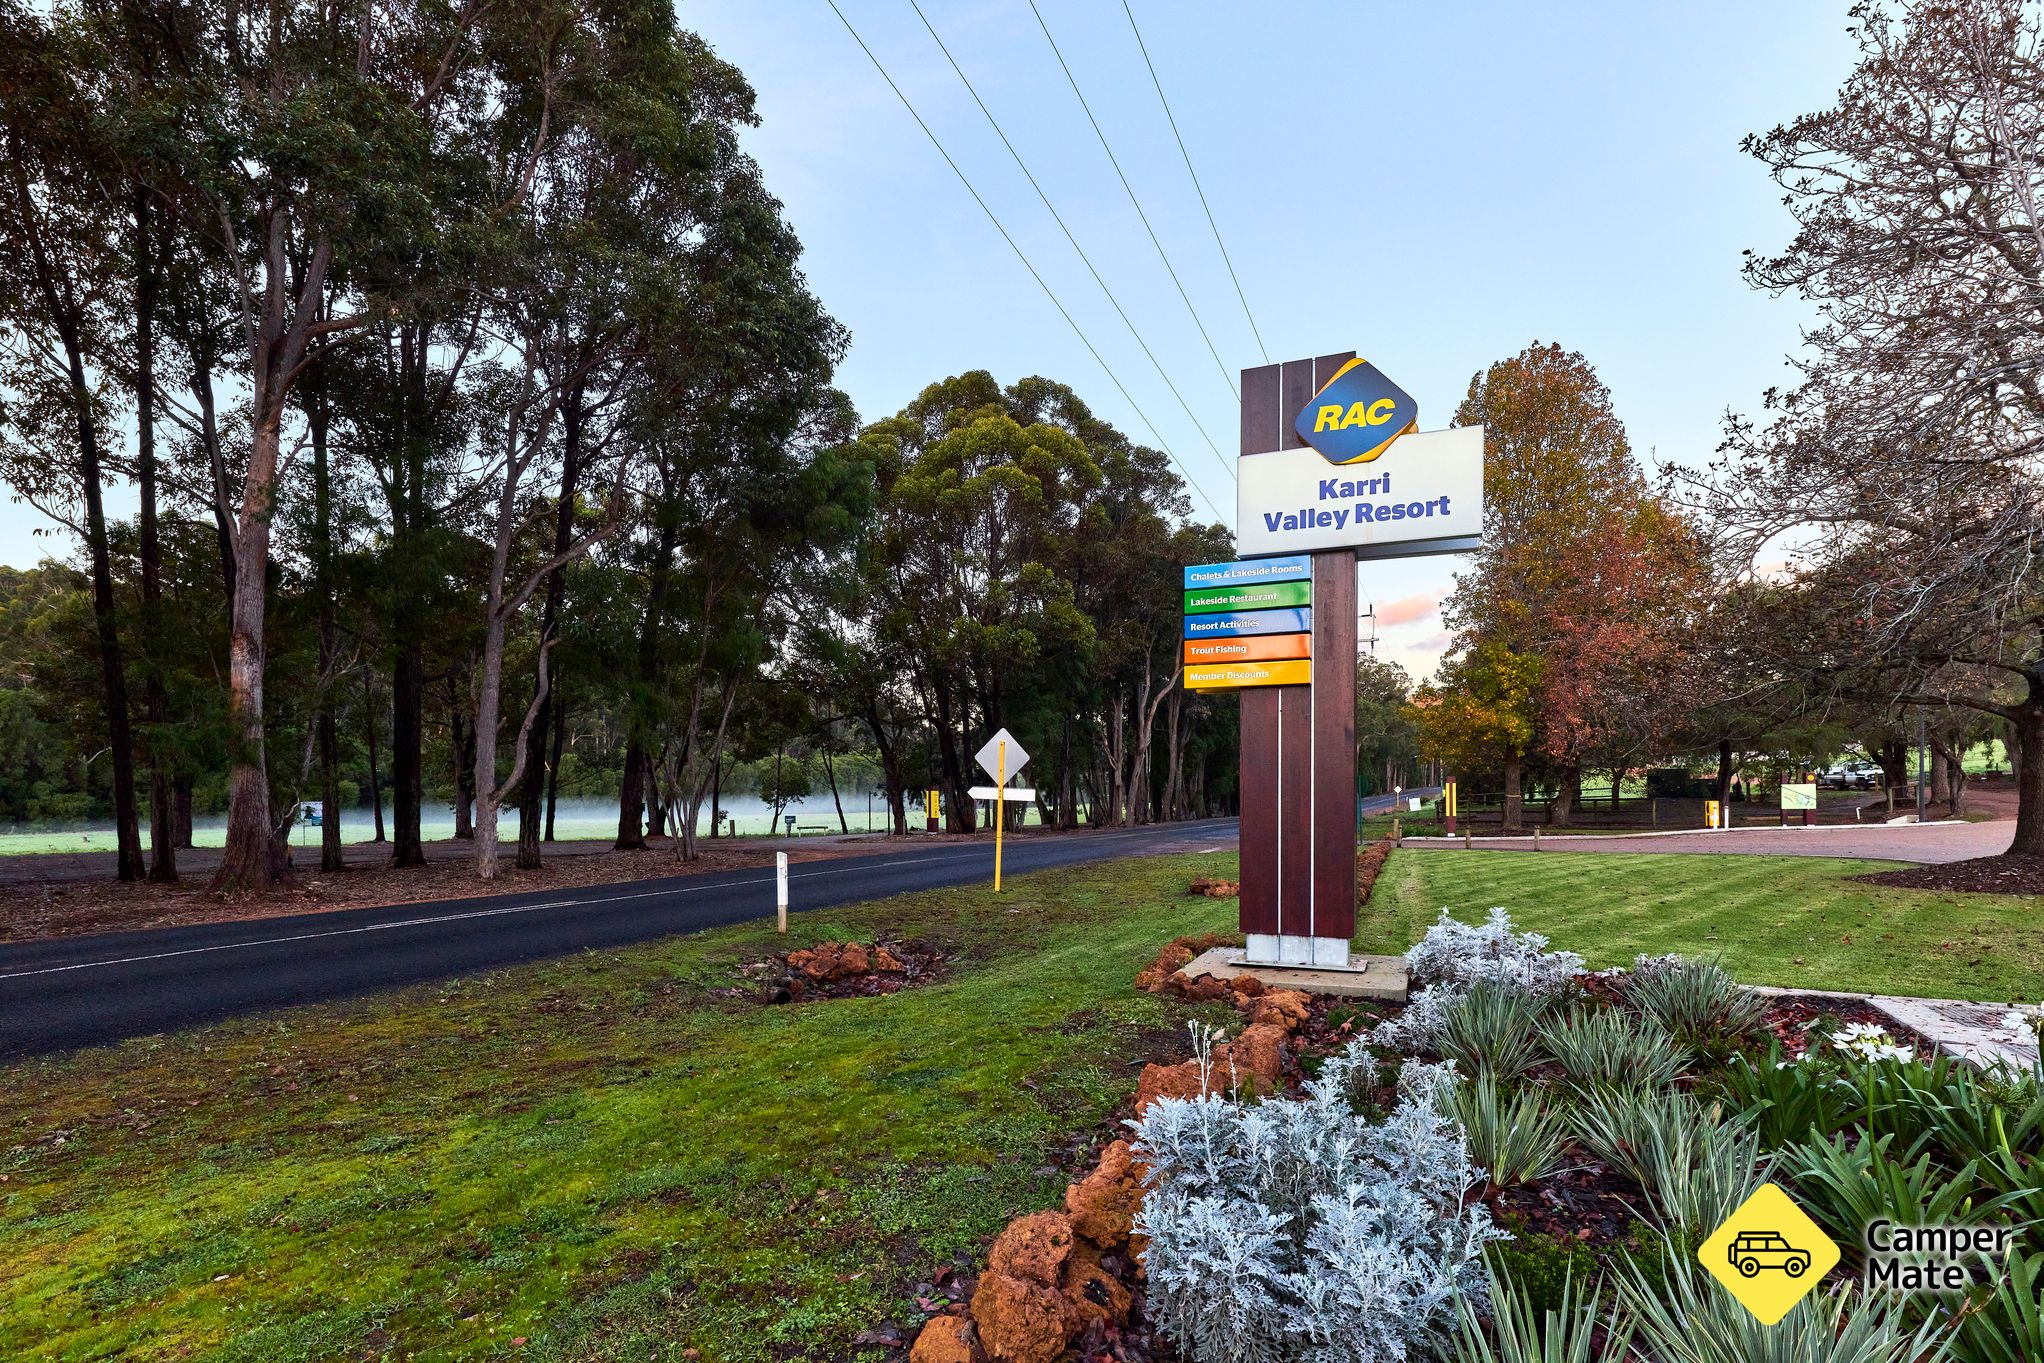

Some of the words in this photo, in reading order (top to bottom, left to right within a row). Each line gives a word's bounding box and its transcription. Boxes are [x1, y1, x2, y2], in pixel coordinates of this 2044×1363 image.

[1314, 398, 1395, 433] RAC
[1319, 472, 1390, 500] Karri
[1264, 508, 1349, 532] Valley
[1355, 495, 1450, 523] Resort
[1190, 572, 1222, 581] Chalets
[1223, 571, 1231, 579] &
[1231, 567, 1270, 578] Lakeside
[1271, 565, 1302, 573] Rooms
[1190, 596, 1228, 606] Lakeside
[1229, 593, 1277, 603] Restaurant
[1190, 622, 1218, 631] Resort
[1219, 619, 1260, 629] Activities
[1190, 646, 1214, 655] Trout
[1215, 645, 1247, 654] Fishing
[1190, 672, 1225, 681] Member
[1226, 670, 1269, 679] Discounts
